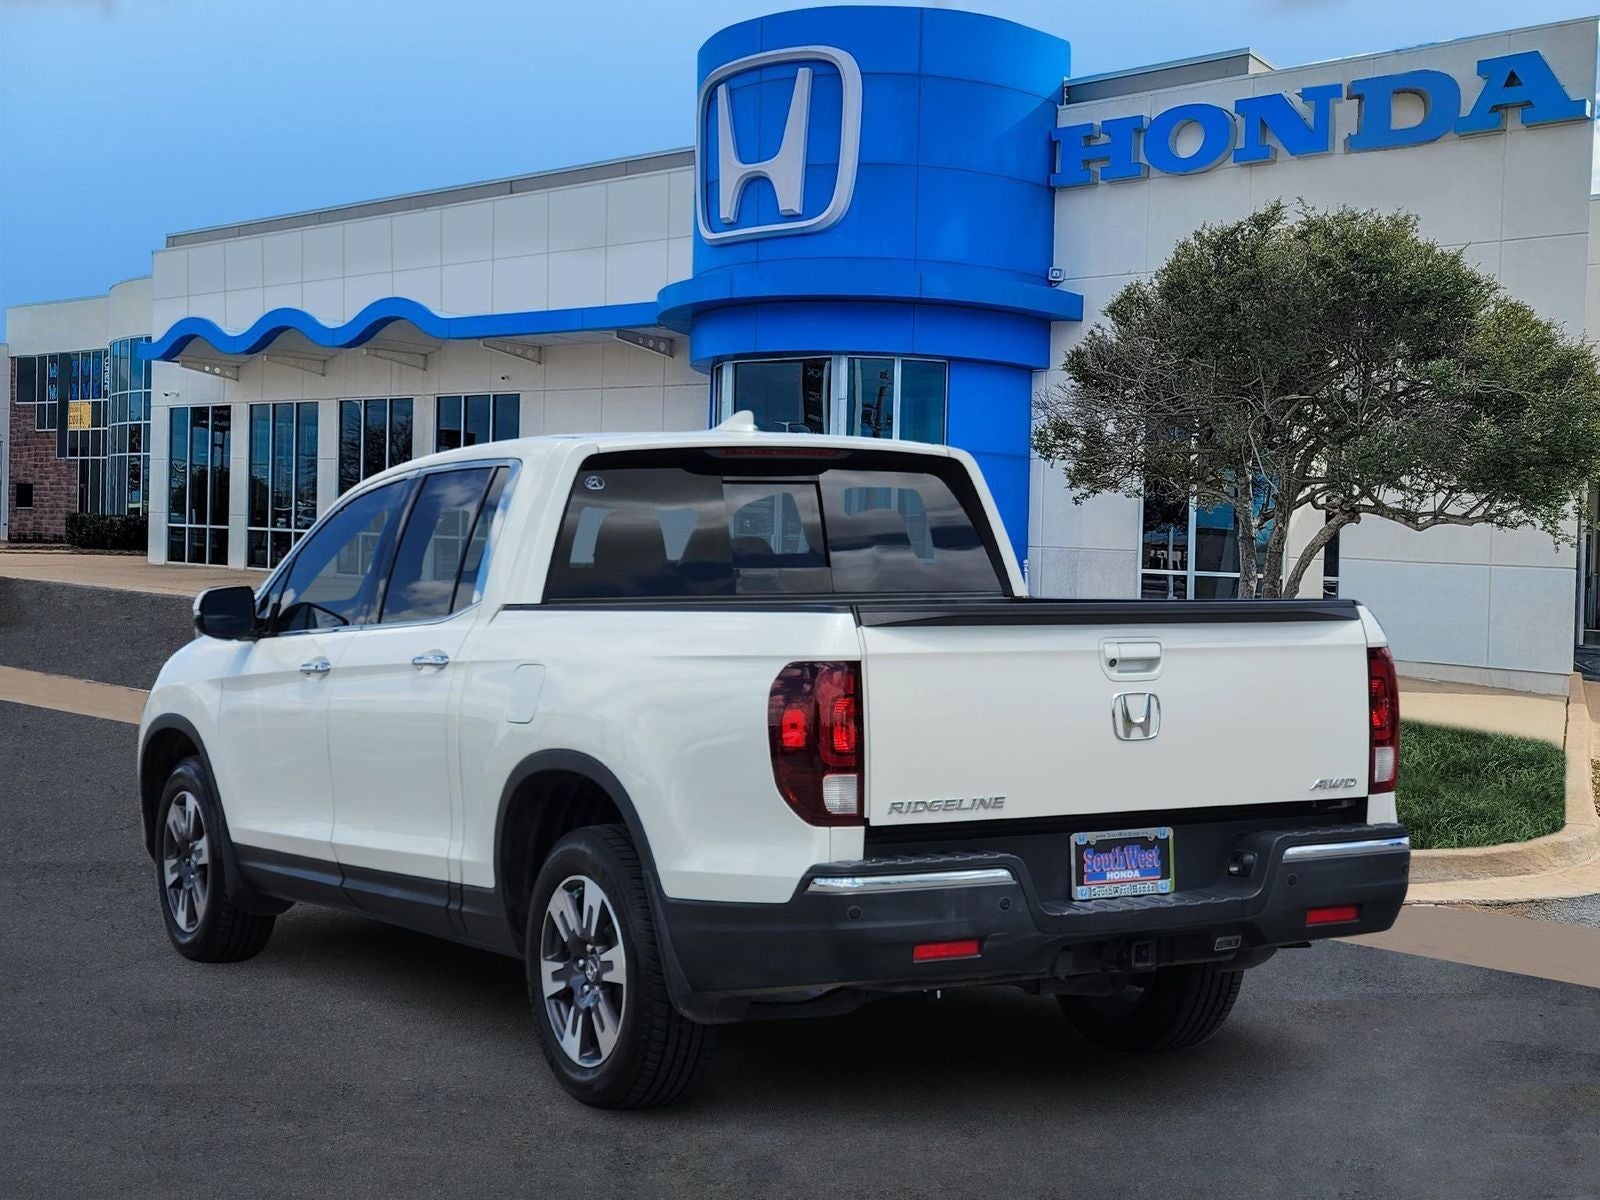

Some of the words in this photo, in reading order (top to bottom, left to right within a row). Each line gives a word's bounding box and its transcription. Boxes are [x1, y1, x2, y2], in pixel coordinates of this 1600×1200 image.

[1050, 50, 1592, 189] HONDA
[1309, 778, 1358, 791] AWD
[887, 796, 1006, 815] RIDGELINE
[1106, 870, 1140, 880] HONDA
